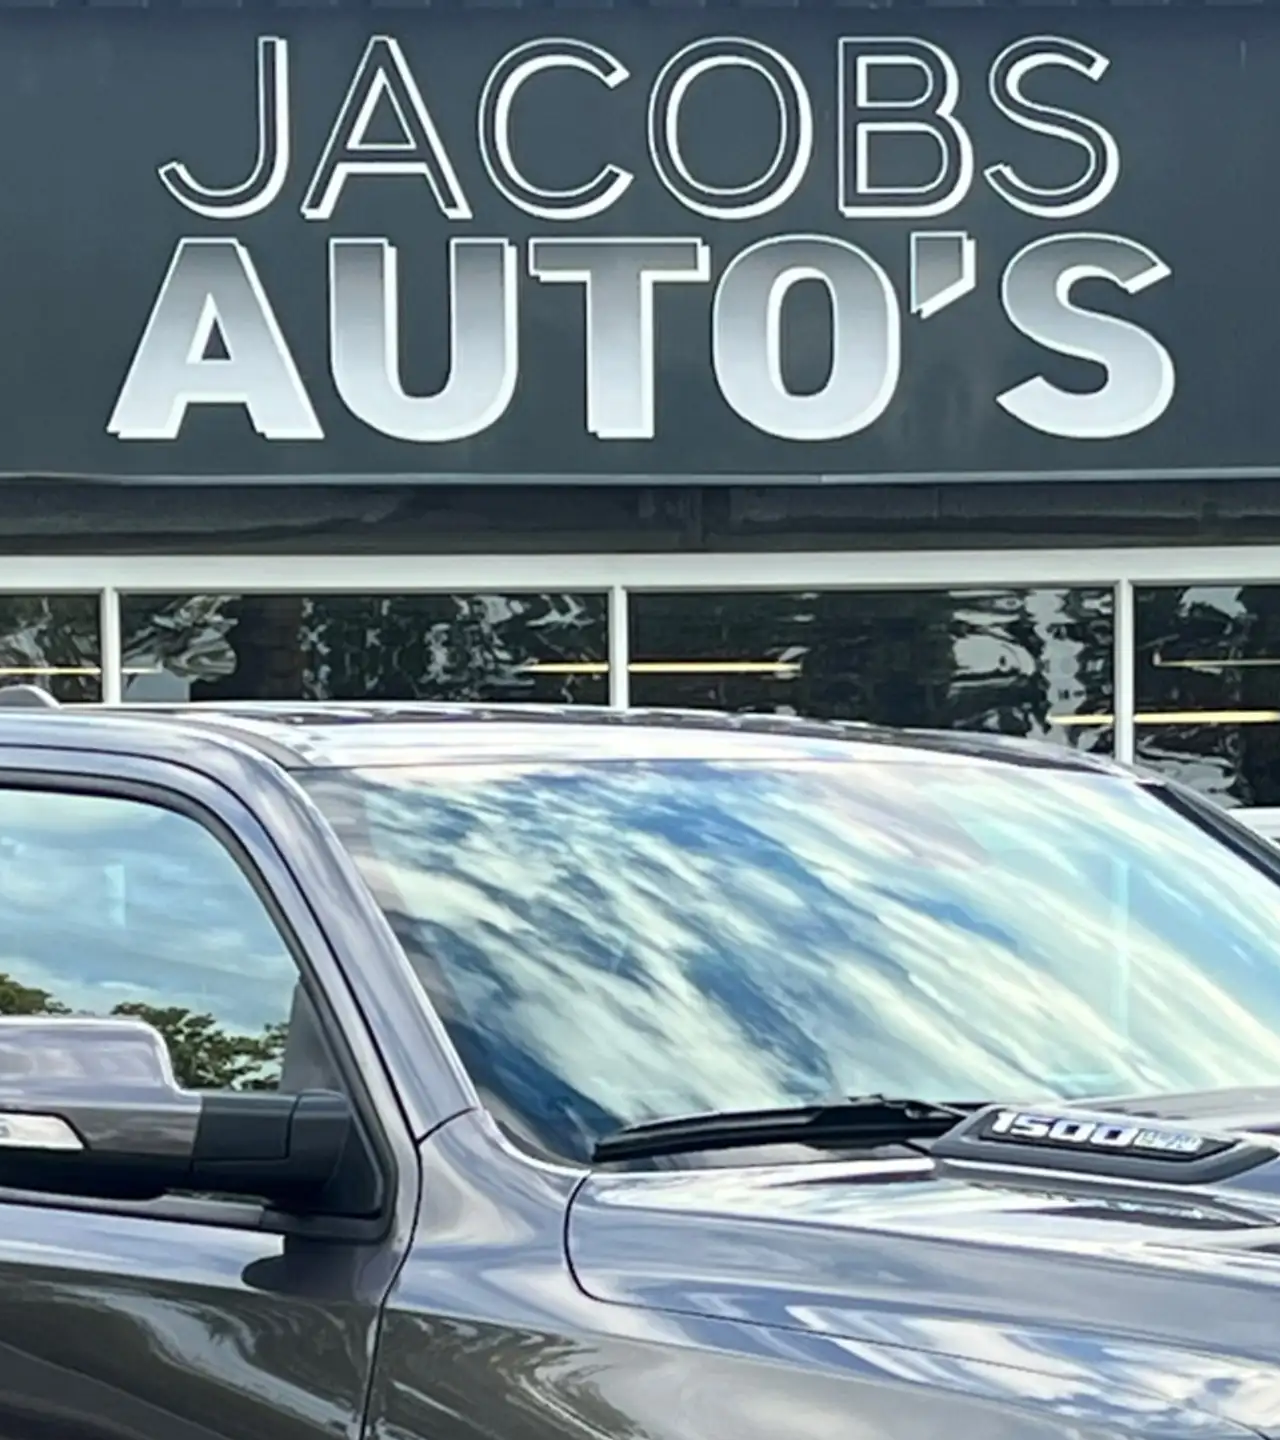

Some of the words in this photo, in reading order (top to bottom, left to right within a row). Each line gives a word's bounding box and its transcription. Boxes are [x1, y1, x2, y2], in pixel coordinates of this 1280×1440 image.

[157, 35, 1122, 220] JACOBS
[106, 231, 1176, 442] AUTO'S
[990, 1111, 1138, 1147] 1500
